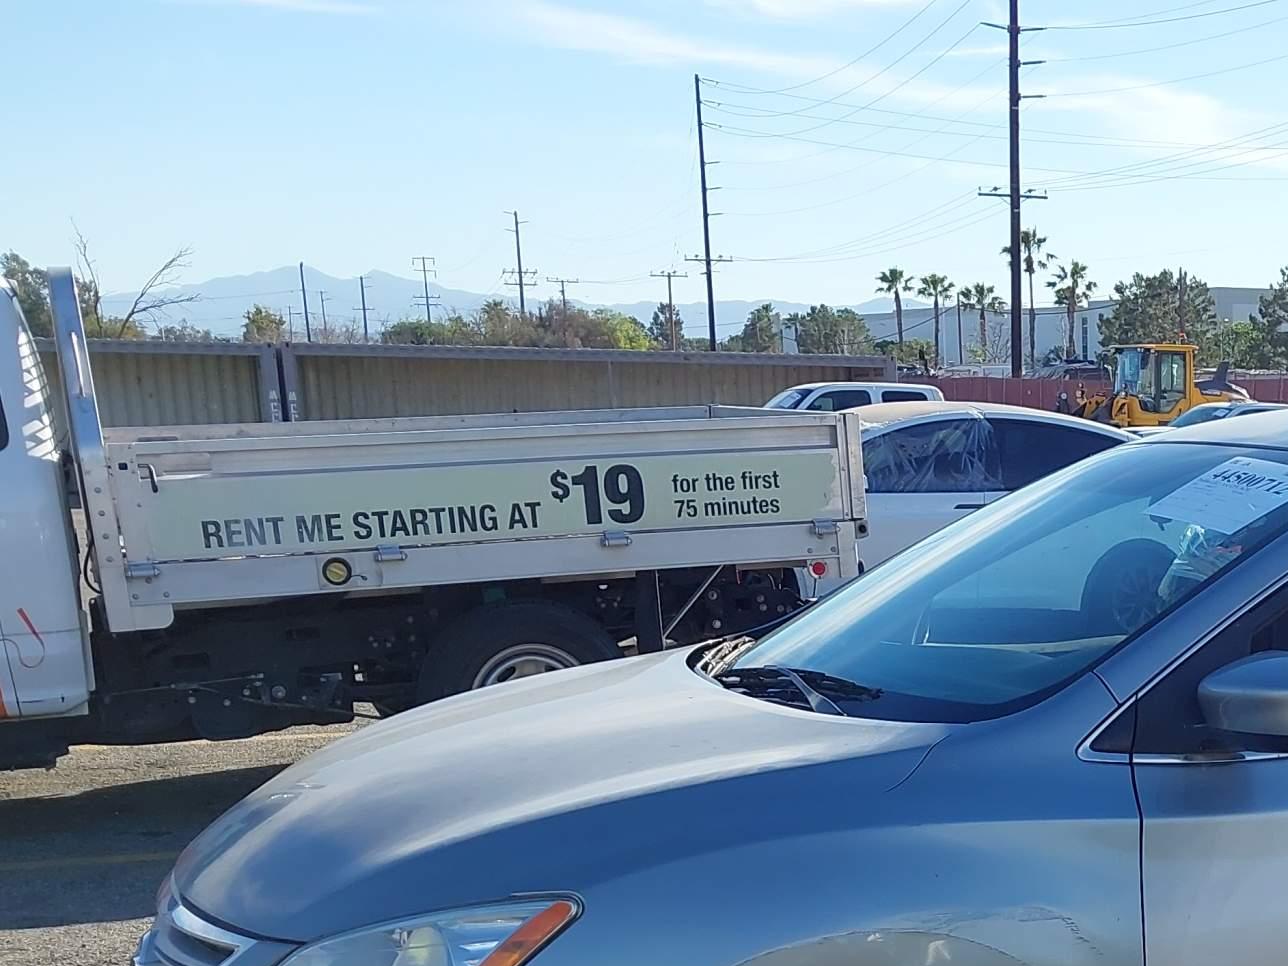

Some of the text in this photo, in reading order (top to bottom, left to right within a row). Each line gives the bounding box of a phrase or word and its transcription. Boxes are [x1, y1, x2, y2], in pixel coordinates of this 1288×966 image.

[672, 470, 780, 493] for the first
[201, 464, 645, 549] RENT ME STARTING AT $19
[674, 496, 780, 518] 75 minutes
